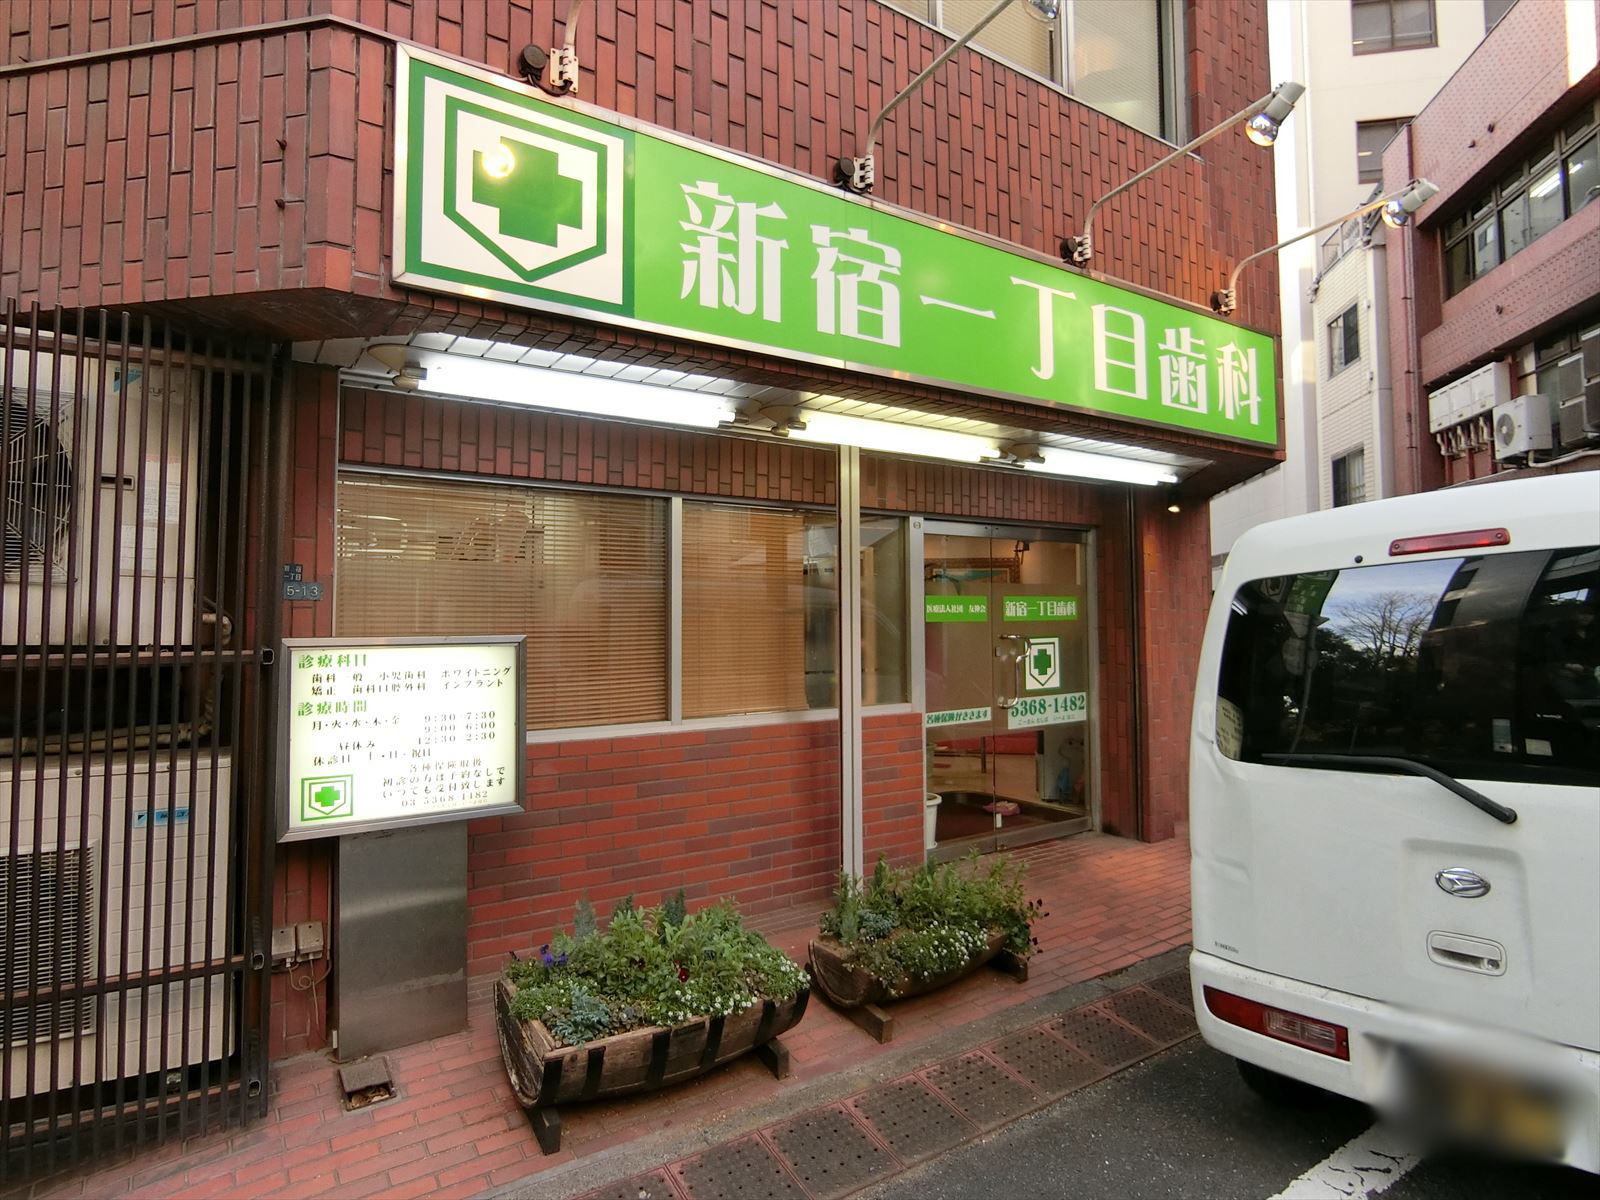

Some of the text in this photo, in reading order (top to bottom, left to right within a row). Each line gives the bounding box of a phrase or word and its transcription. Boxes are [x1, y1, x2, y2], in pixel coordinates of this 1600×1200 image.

[679, 180, 1262, 427] 新宿一丁目歯科
[1005, 600, 1076, 617] 新宿一丁目歯科
[298, 653, 367, 669] 診療科目
[440, 665, 512, 679] ホワイトニング
[297, 700, 367, 717] 診療時間
